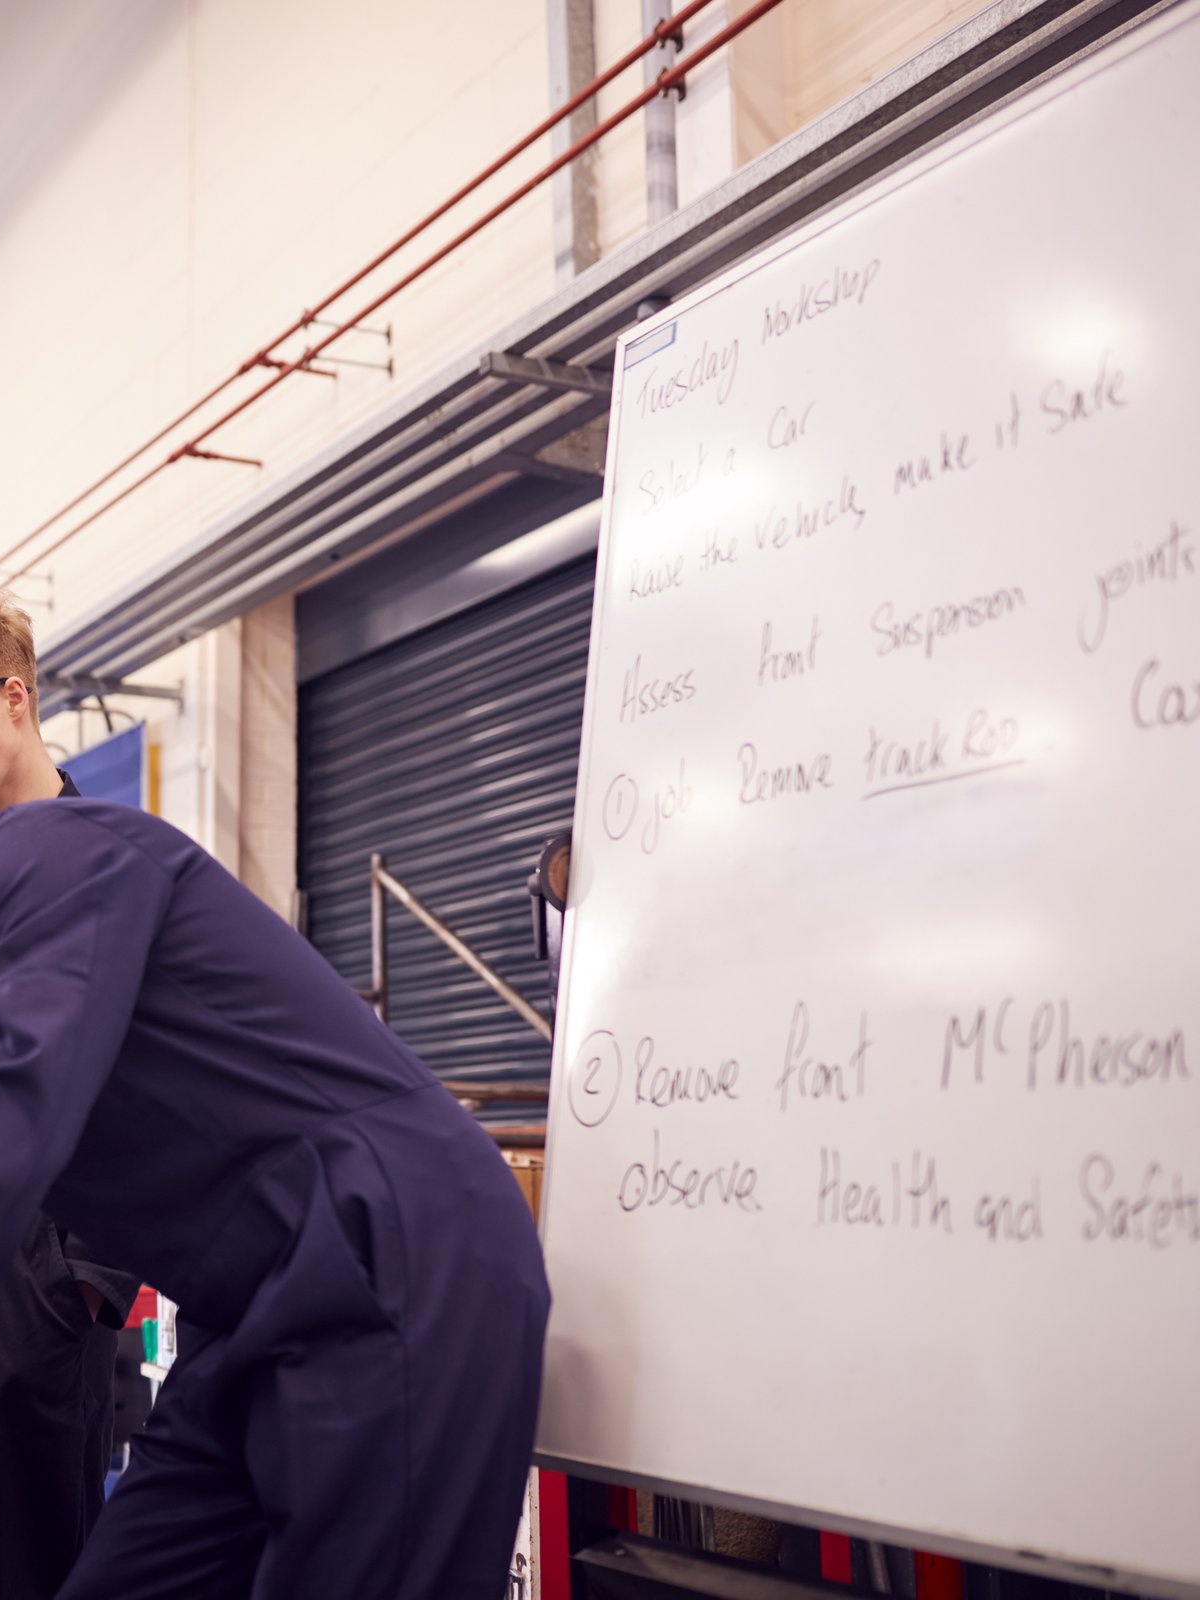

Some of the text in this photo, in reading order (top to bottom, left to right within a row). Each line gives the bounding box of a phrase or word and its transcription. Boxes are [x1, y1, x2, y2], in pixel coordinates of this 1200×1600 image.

[636, 256, 881, 421] Tuesday Workshop
[628, 553, 685, 602] Raise
[698, 525, 739, 572] the
[893, 430, 978, 496] make
[994, 390, 1021, 451] it
[1039, 347, 1131, 435] Safe
[721, 446, 737, 478] a
[766, 400, 817, 450] Car
[619, 652, 698, 724] Assess
[757, 614, 824, 688] front
[1076, 517, 1196, 656] joints
[639, 755, 694, 856] job
[736, 740, 836, 806] Remove
[862, 723, 950, 785] track
[634, 1034, 742, 1108] Remove
[774, 998, 876, 1114] front
[816, 1144, 956, 1237] Health
[972, 1168, 1045, 1244] and
